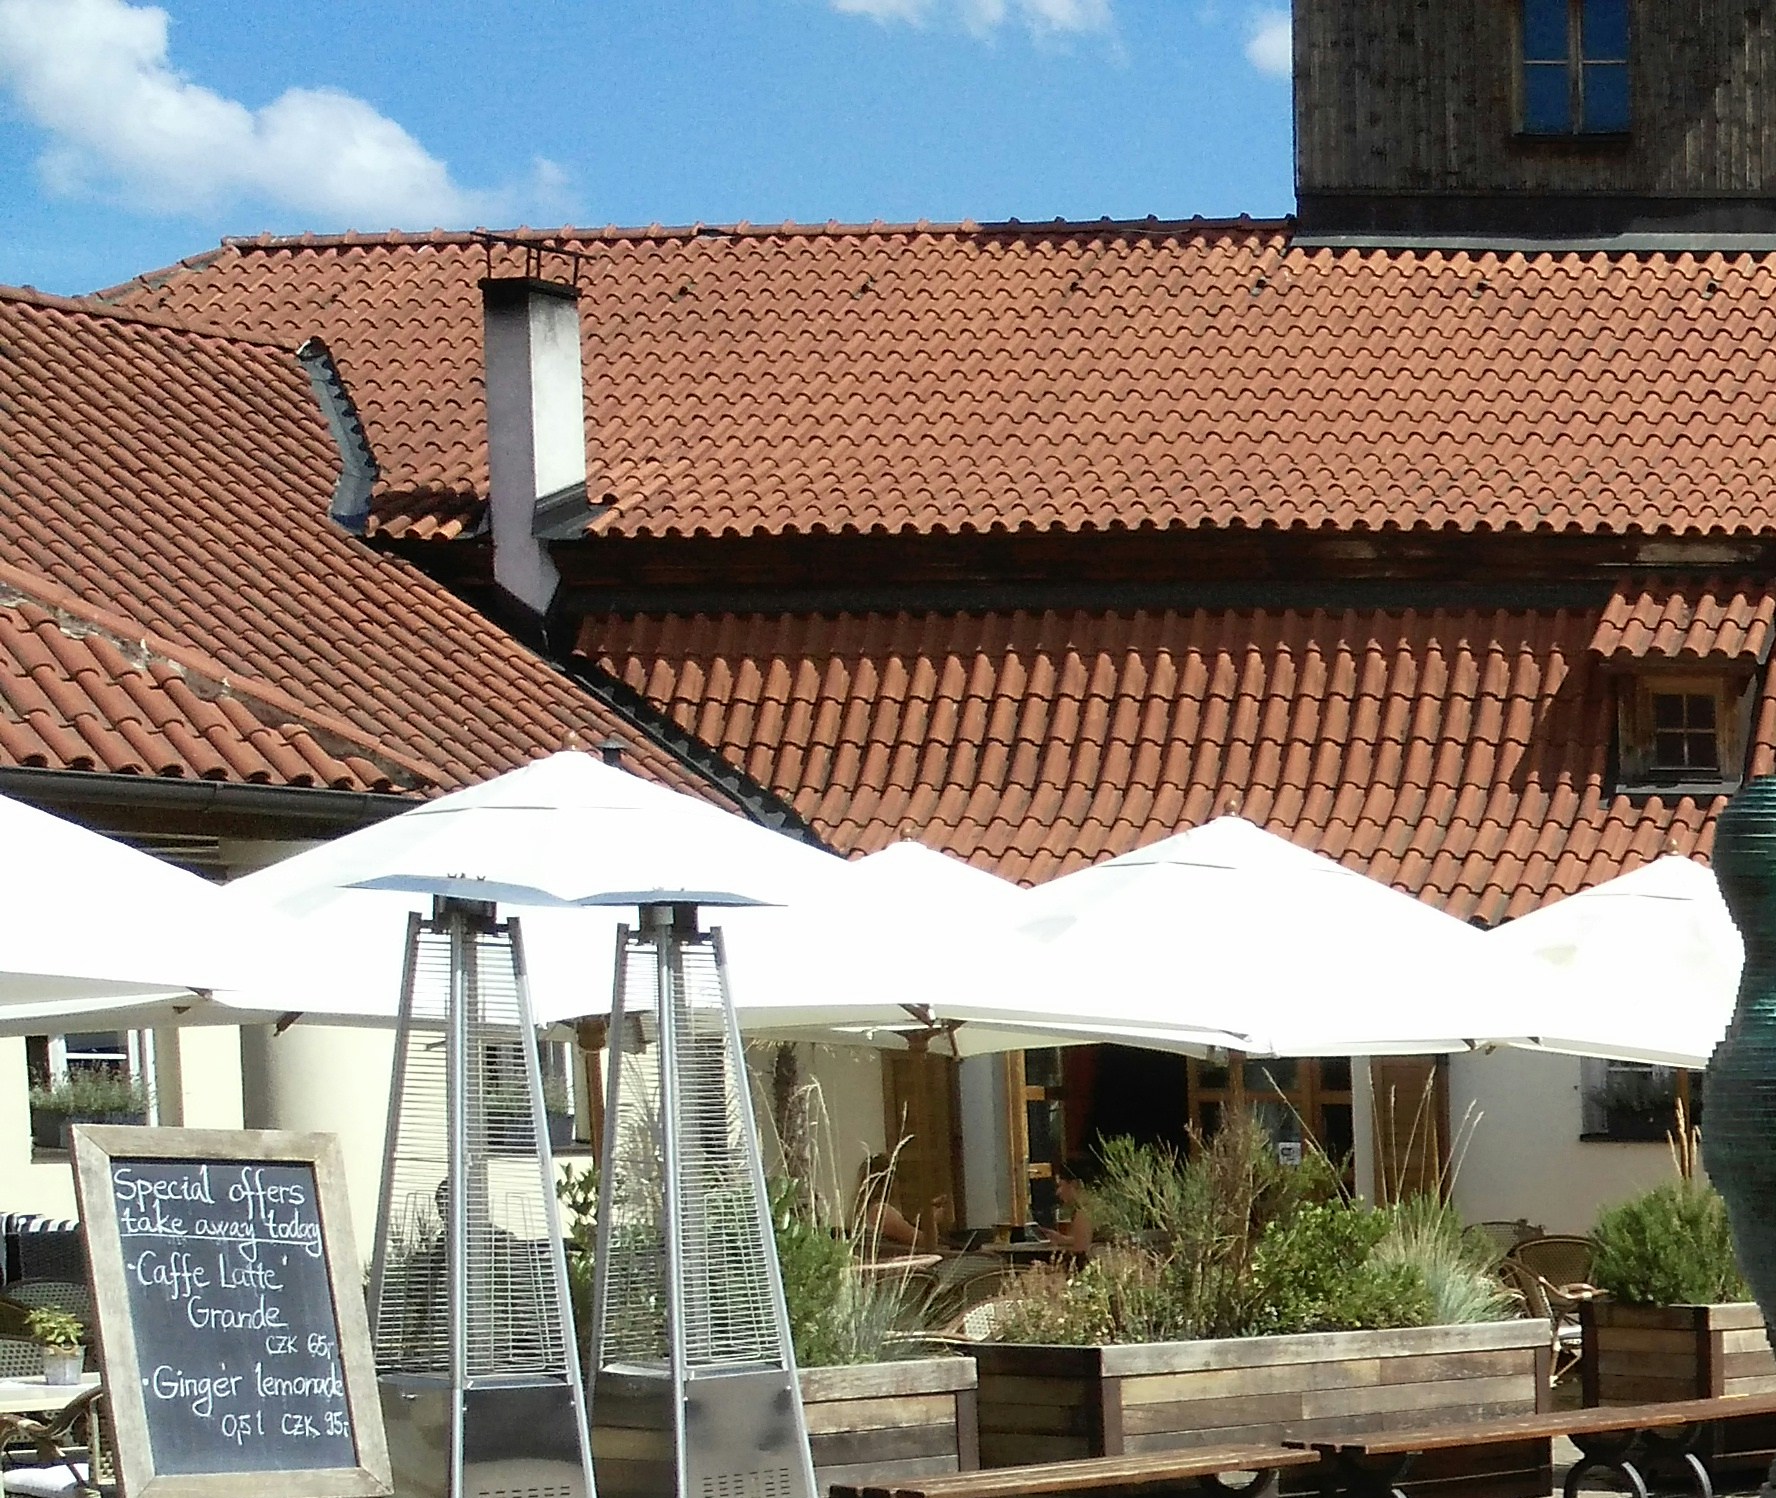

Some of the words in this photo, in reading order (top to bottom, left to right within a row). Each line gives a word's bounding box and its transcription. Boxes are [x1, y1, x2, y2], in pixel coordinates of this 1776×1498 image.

[113, 1164, 216, 1213] Special
[228, 1166, 305, 1220] offers
[120, 1198, 188, 1235] take
[195, 1220, 257, 1263] away
[265, 1207, 323, 1258] today
[187, 1294, 289, 1332] Grande
[265, 1335, 299, 1355] CZK
[255, 1362, 344, 1398] lemonade
[281, 1412, 321, 1438] CZK
